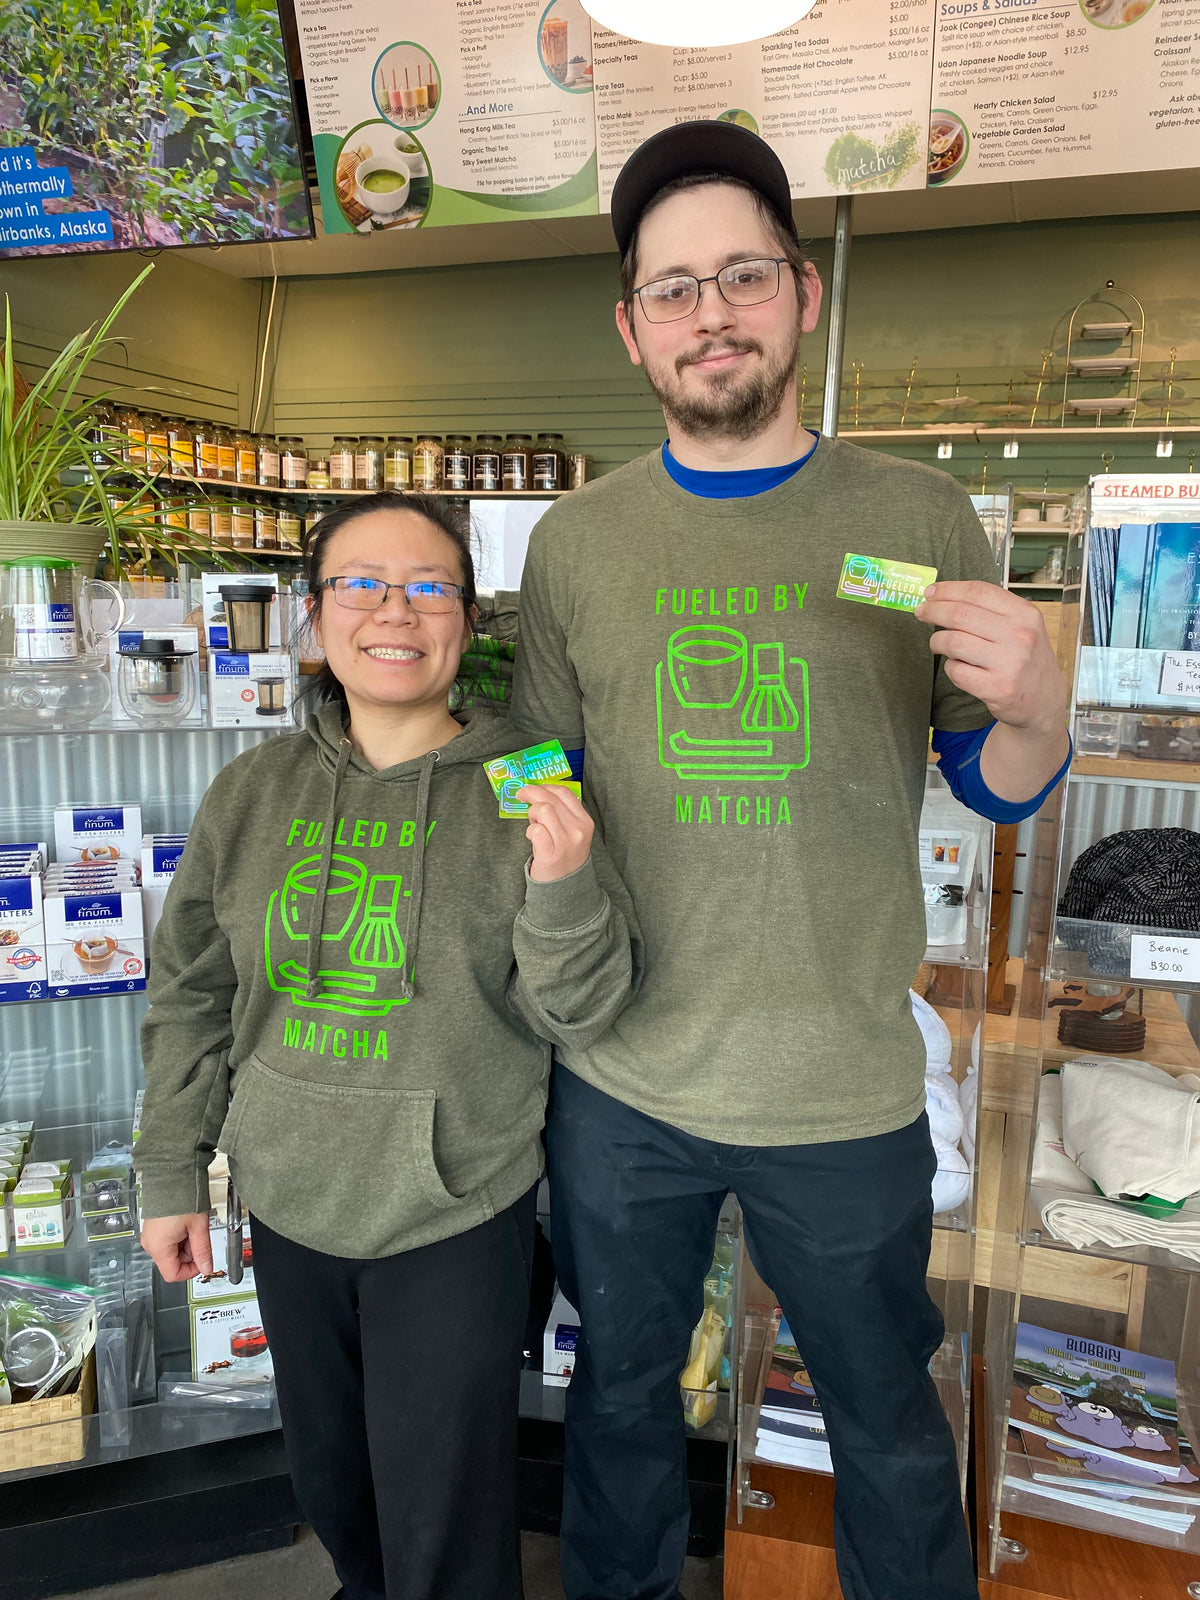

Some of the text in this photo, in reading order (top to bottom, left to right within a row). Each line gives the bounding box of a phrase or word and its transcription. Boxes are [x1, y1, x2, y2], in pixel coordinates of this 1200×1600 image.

[941, 2, 978, 16] Soups
[982, 0, 990, 10] &
[810, 12, 823, 20] Bolt
[889, 13, 909, 23] $5.00
[939, 10, 1071, 32] Jook (Congee) Chinese Rice Soup
[888, 27, 920, 37] $5.00/16
[1066, 28, 1087, 38] $8.50
[761, 37, 829, 53] Sparkling Tea Sodas
[888, 37, 916, 47] Midnight
[917, 36, 928, 44] Sun
[1154, 34, 1192, 45] Reindeer
[888, 50, 919, 61] $5.00/16
[1064, 45, 1090, 55] $12.95
[1154, 46, 1192, 56] Croissant
[593, 54, 638, 65] Specialty Teas
[673, 52, 733, 66] Pot: $8.00/serves 3
[938, 49, 1048, 69] Udon Japanese Noodle Soup
[1161, 59, 1189, 67] Alaskan
[761, 57, 854, 75] Homemade Hot Chocolate
[962, 67, 987, 76] cooked
[988, 65, 1014, 74] veggies
[1015, 62, 1029, 70] and
[1030, 60, 1053, 68] choice
[673, 71, 708, 83] Cup: $5.00
[595, 83, 609, 91] Rare
[673, 80, 733, 93] Pot: $8.00/serves 3
[1092, 89, 1118, 100] $12.95
[1169, 94, 1185, 103] Ask
[488, 103, 514, 113] More
[973, 96, 1056, 110] Hearty Chicken Salad
[596, 114, 615, 122] Yerba
[651, 106, 678, 116] American
[678, 105, 697, 115] Energy
[697, 102, 716, 110] Herbal
[459, 127, 475, 135] Hong
[476, 125, 491, 133] Kong
[492, 123, 504, 131] Milk
[972, 124, 1065, 140] Vegetable Garden Salad
[461, 147, 484, 156] Organic
[12, 155, 32, 171] it's
[476, 157, 494, 165] Sweet
[837, 150, 901, 183] matcha
[0, 176, 65, 197] thermally
[25, 202, 39, 217] in
[0, 220, 107, 242] irbanks, Alaska
[1103, 484, 1200, 499] STEAMED BU
[880, 578, 916, 594] FUELED
[656, 582, 809, 615] FUELED BY
[878, 589, 927, 608] MATCH
[1187, 631, 1199, 640] BY
[218, 663, 246, 673] finum
[1167, 657, 1182, 667] The
[523, 757, 552, 774] FUELED
[553, 753, 565, 763] BY
[526, 763, 569, 780] MATCHA
[675, 794, 792, 825] MATCHA
[1148, 940, 1191, 956] Beanie
[1150, 960, 1183, 973] $30.00
[283, 1017, 388, 1061] MATCHA
